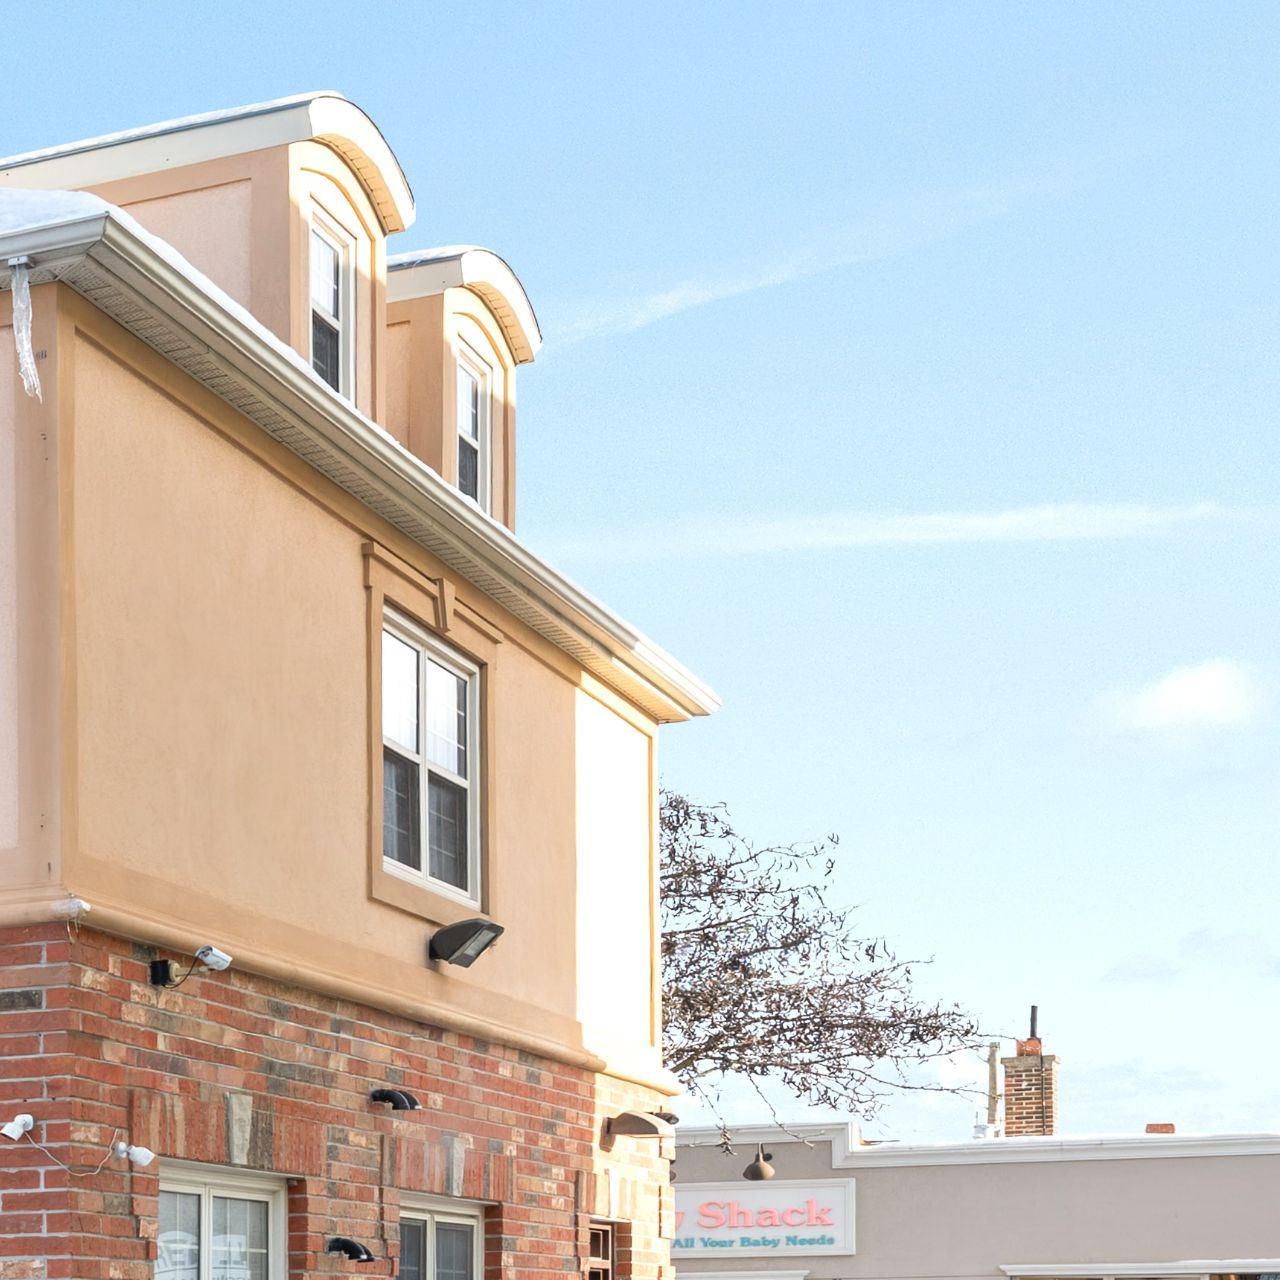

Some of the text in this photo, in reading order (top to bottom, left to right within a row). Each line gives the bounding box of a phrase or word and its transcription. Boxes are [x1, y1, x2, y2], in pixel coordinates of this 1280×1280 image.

[696, 1199, 834, 1229] Shack
[671, 1235, 835, 1249] All Your Baby Needs
